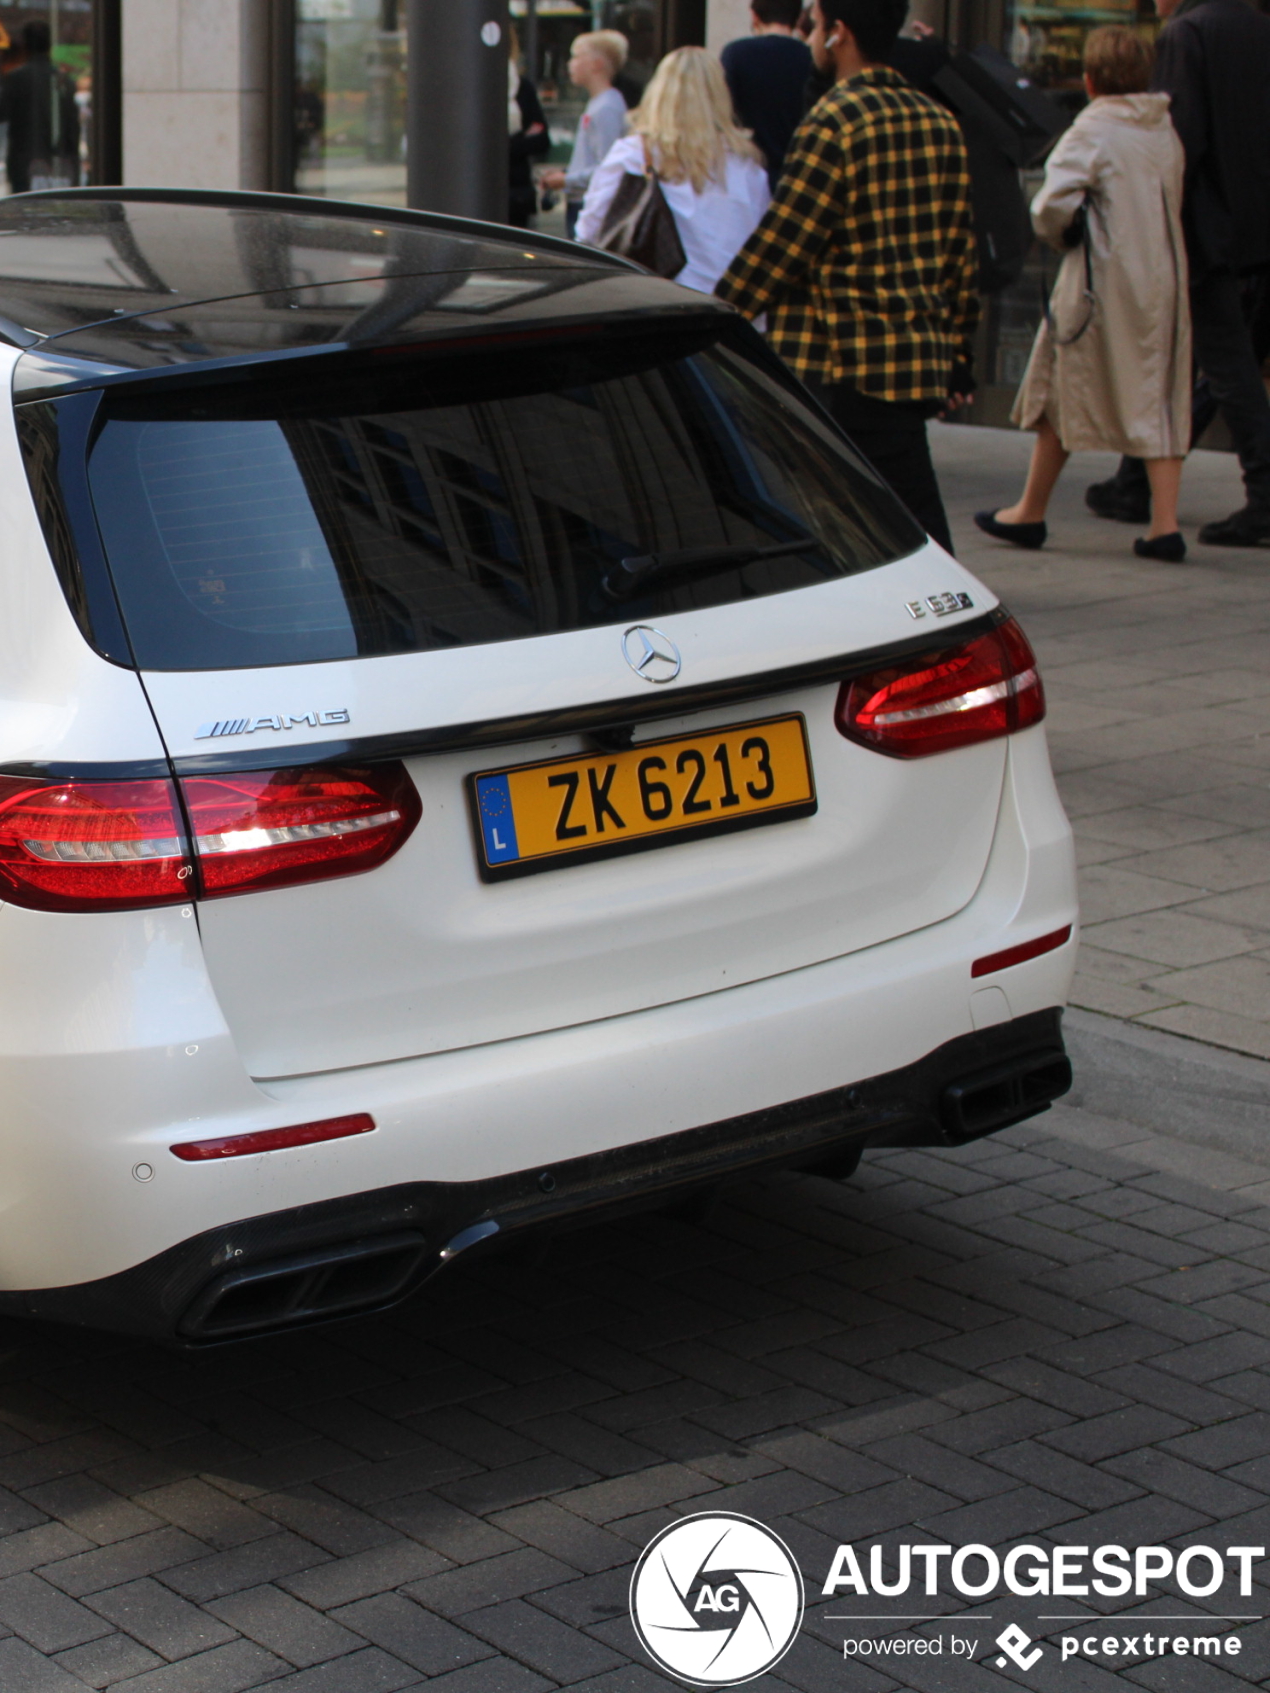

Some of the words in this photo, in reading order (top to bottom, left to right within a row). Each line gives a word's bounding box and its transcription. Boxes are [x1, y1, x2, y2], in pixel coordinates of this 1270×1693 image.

[546, 763, 627, 841] ZK
[637, 736, 775, 821] 6213
[492, 828, 506, 850] L
